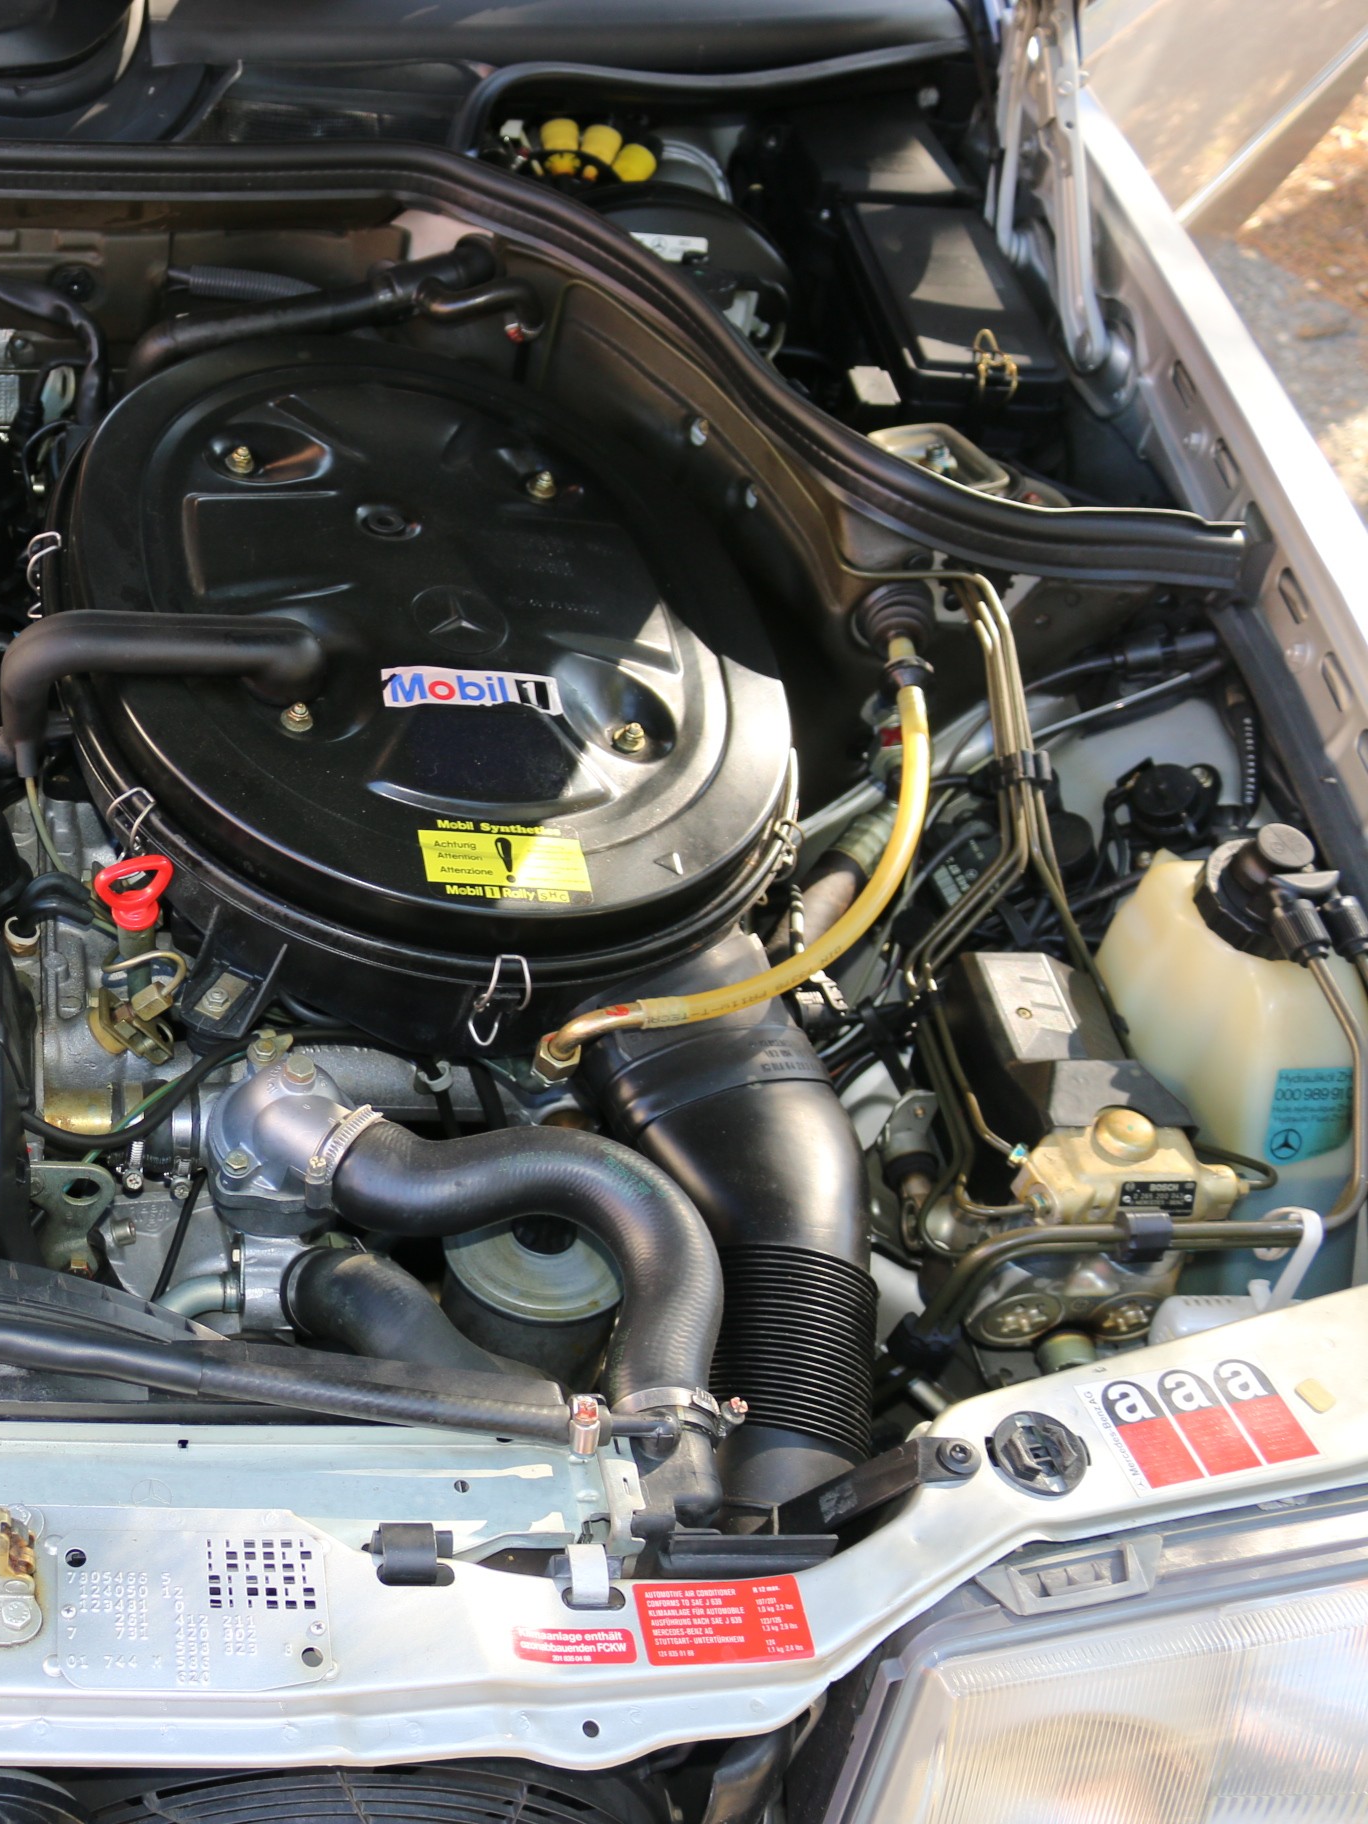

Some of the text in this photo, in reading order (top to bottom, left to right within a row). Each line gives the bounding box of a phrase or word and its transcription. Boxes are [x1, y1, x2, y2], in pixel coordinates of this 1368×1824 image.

[391, 673, 510, 703] Mobil
[435, 819, 562, 837] Mobil Synthetics
[434, 840, 477, 850] Achtung
[438, 852, 483, 861] Attention
[440, 866, 494, 876] Attenzione
[445, 884, 483, 896] Mobil
[502, 889, 536, 901] Rally
[1274, 1088, 1302, 1101] 000
[1303, 1087, 1329, 1101] 989
[1224, 1361, 1270, 1401] a
[1166, 1371, 1214, 1413] a
[1107, 1383, 1157, 1423] a
[79, 1584, 184, 1600] 124050 12
[645, 1590, 683, 1599] AUTOMOTIVE
[696, 1588, 736, 1597] CONDITIONER
[647, 1599, 680, 1608] CONFORMS
[691, 1598, 703, 1606] SAE
[648, 1606, 745, 1617] KLIMAANLAGE FÜR AUTOMOBILE
[175, 1613, 209, 1628] 412
[222, 1614, 256, 1629] 211
[651, 1617, 691, 1627] AUSFÜHRUNG
[693, 1617, 710, 1626] NACH
[710, 1617, 723, 1625] SAE
[584, 1632, 623, 1641] enthält
[652, 1627, 713, 1637] MERCEDES-BENZ AG
[655, 1635, 745, 1646] STUTTGART- UNTERTÜRKHEIM
[597, 1642, 627, 1652] FCKW
